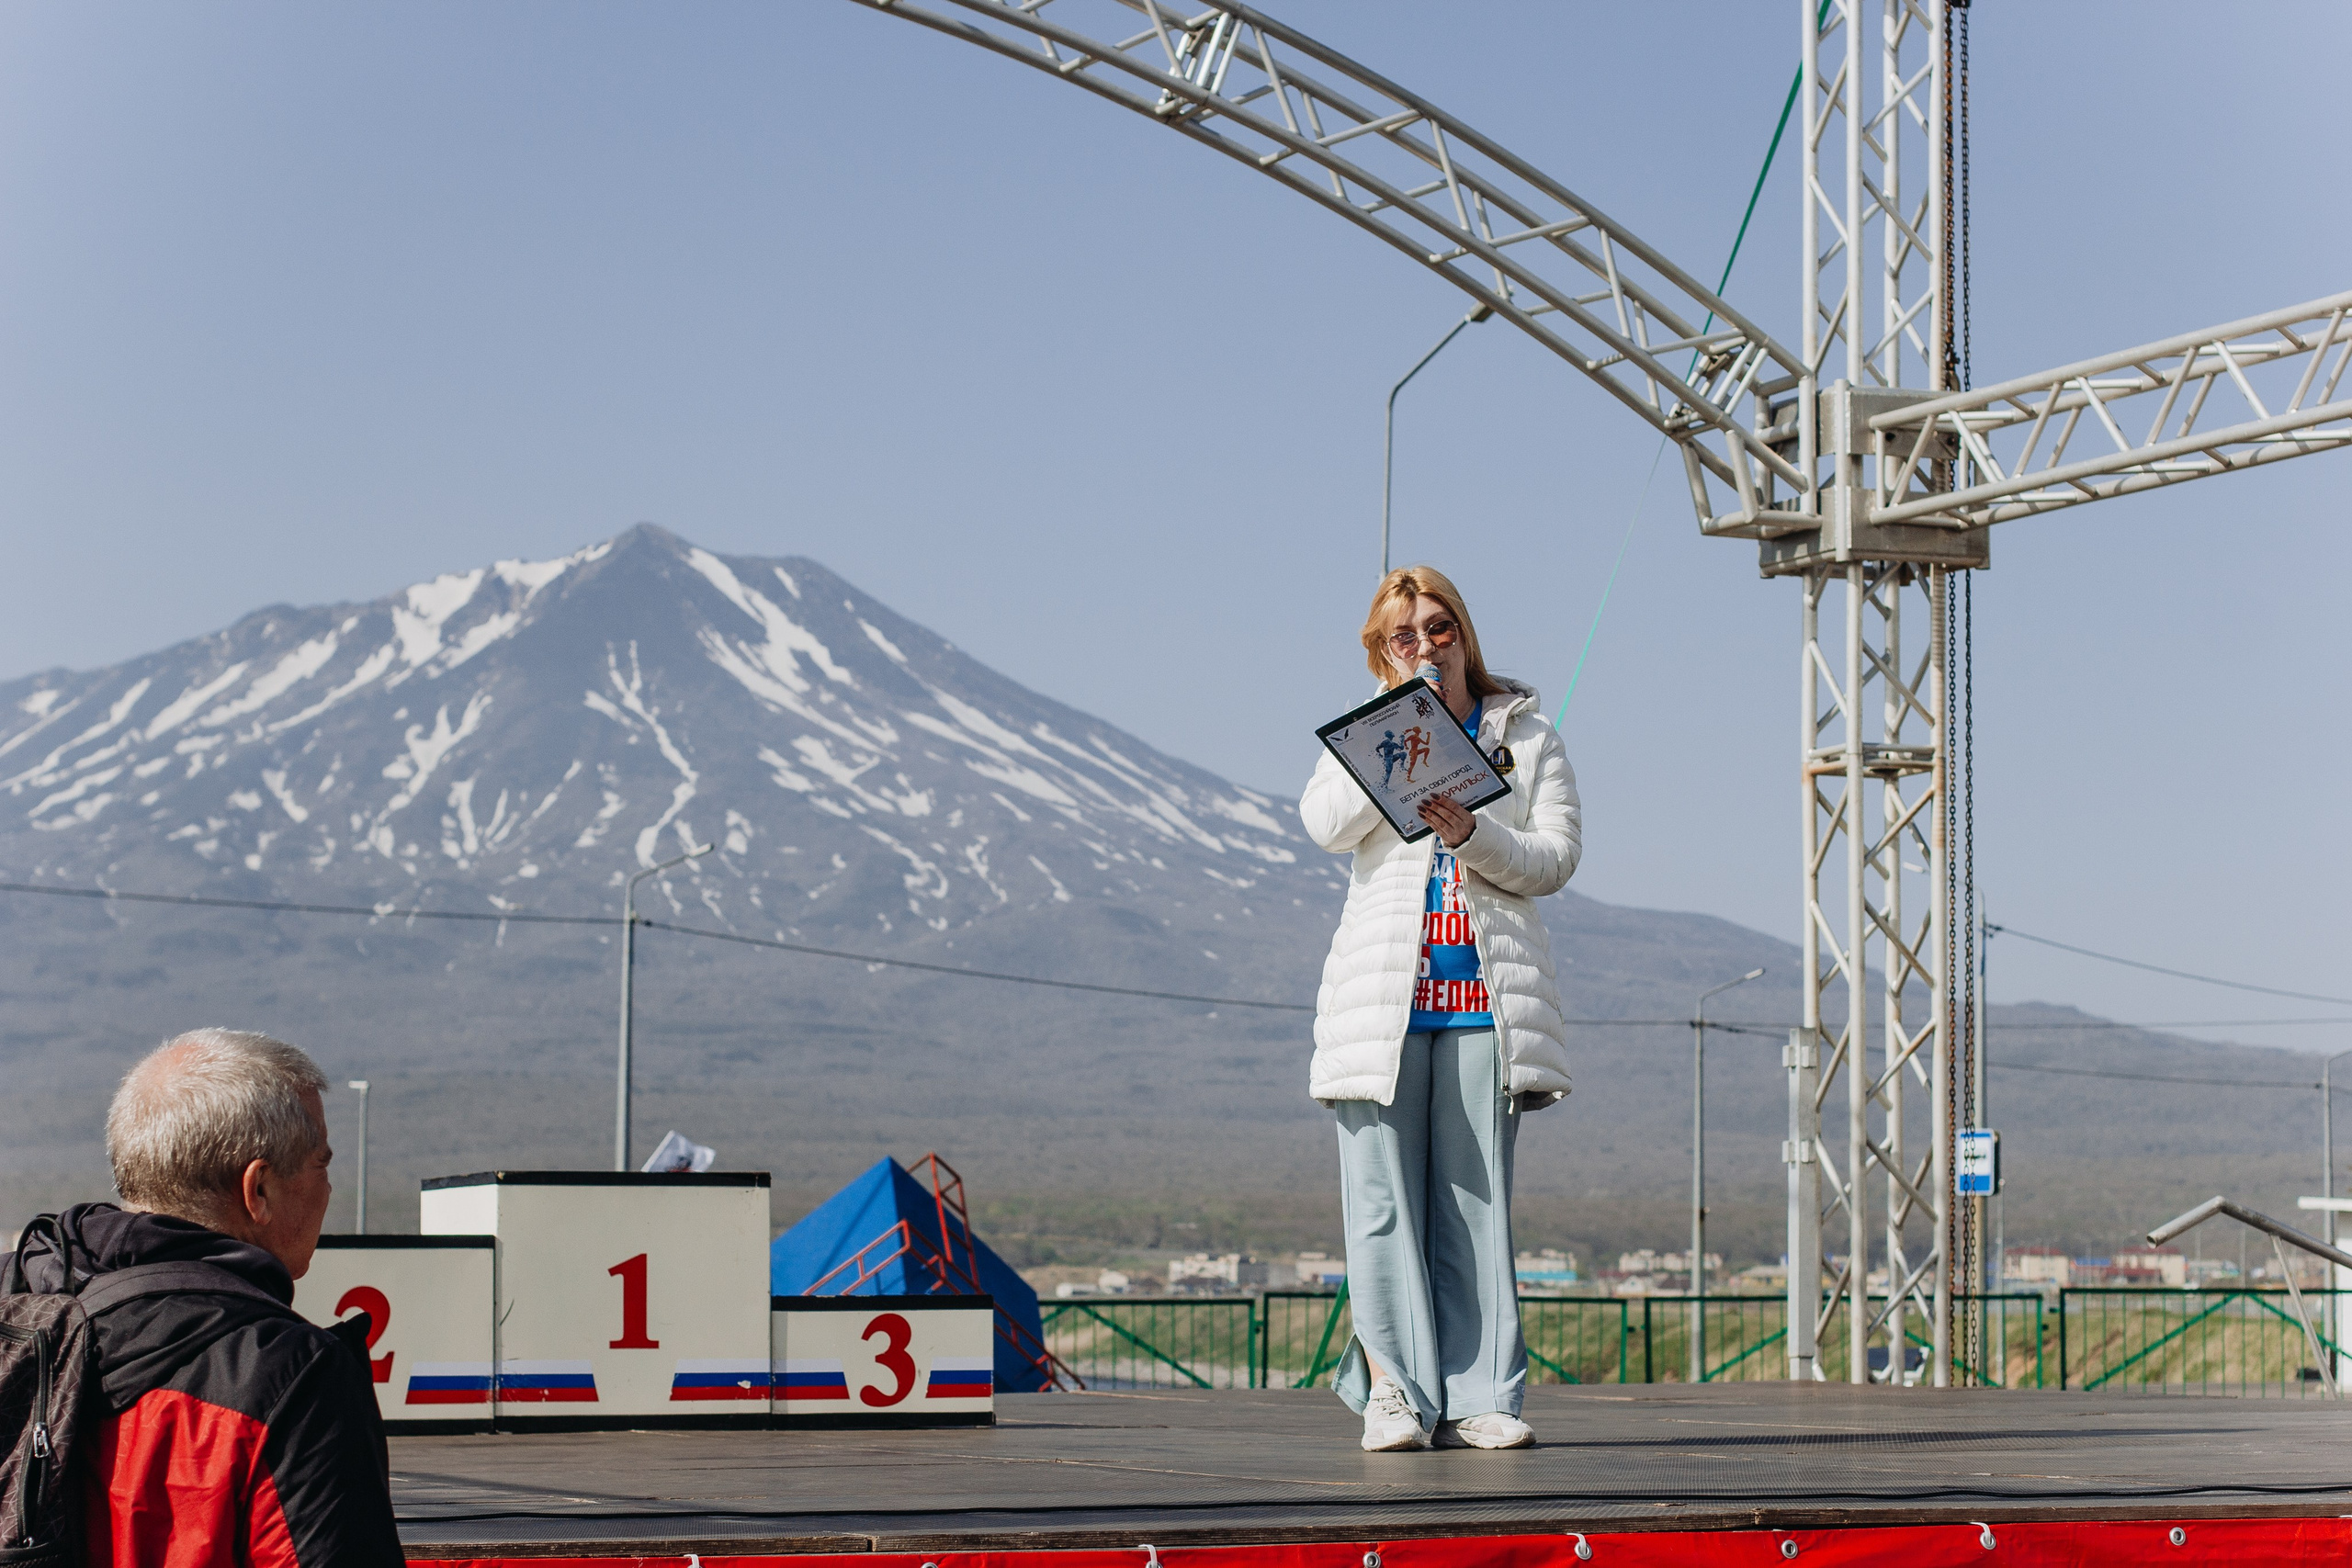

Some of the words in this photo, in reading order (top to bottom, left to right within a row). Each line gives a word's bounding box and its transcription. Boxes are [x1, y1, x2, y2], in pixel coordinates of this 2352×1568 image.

[1399, 790, 1419, 804] БЕГИ
[1418, 786, 1429, 795] ЗА
[1429, 776, 1449, 791] СВОЙ
[1448, 764, 1473, 781] ГОРОД
[334, 1286, 395, 1382] 2
[608, 1253, 660, 1348] 1
[859, 1313, 916, 1406] 3
